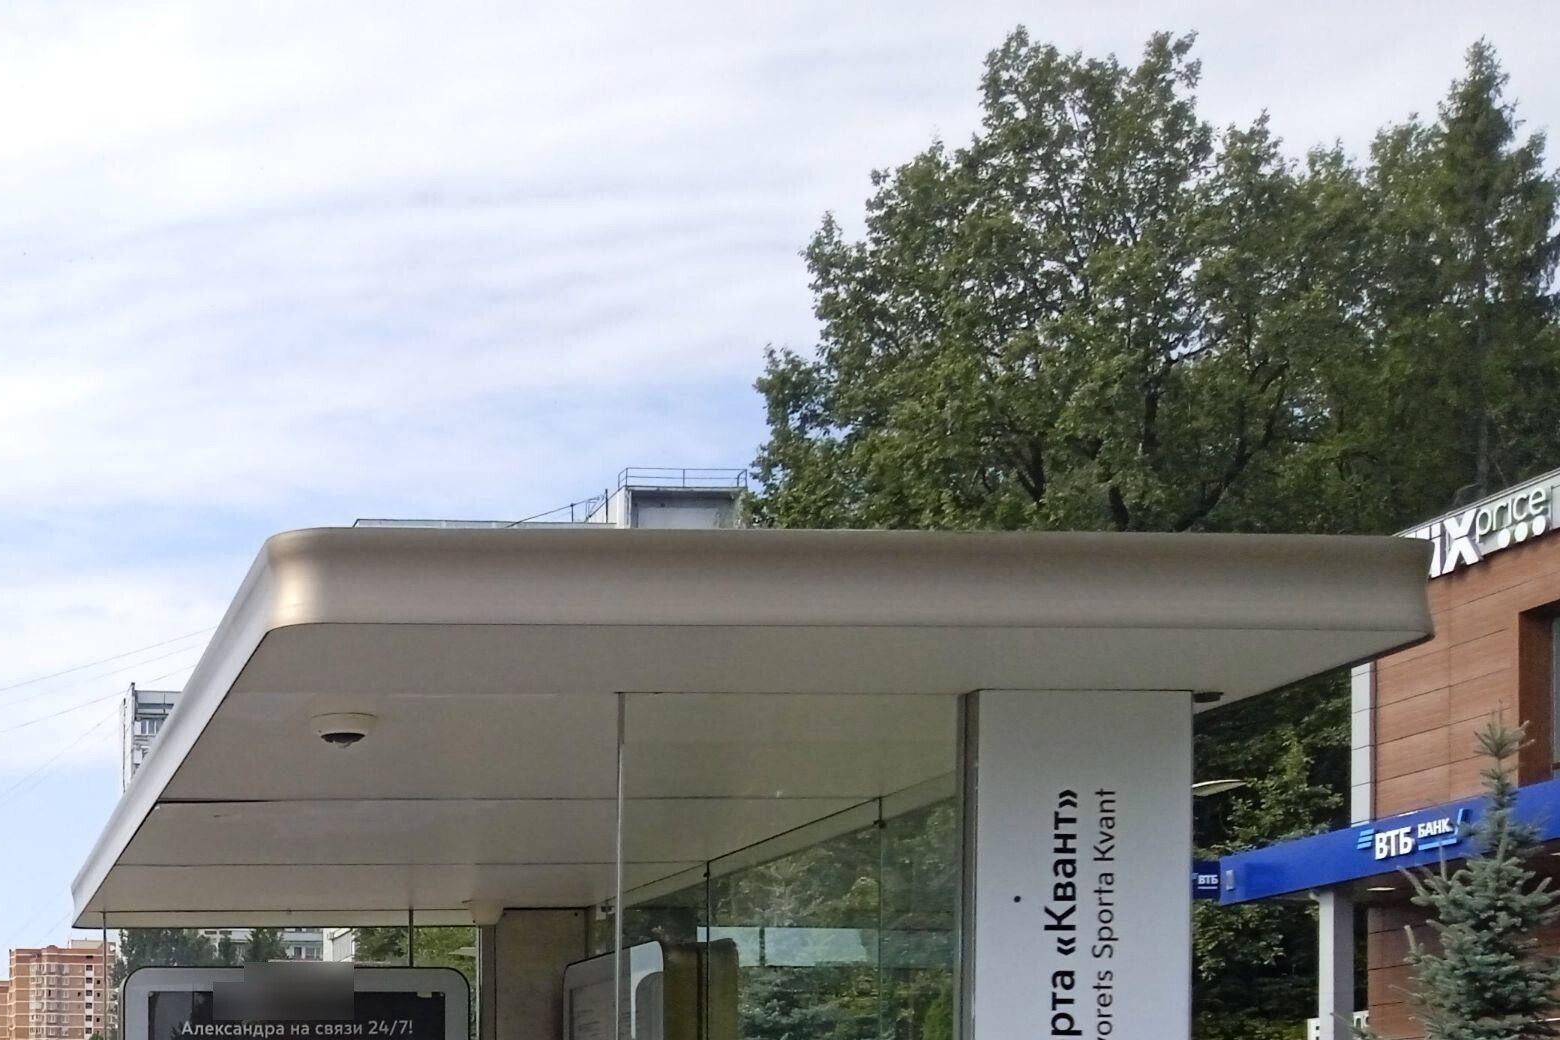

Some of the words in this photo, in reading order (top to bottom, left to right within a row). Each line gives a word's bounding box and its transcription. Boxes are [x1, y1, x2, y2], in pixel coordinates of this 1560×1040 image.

[1476, 487, 1547, 544] price
[1092, 787, 1118, 862] Kvant
[1374, 826, 1413, 860] ВТБ
[1417, 817, 1452, 838] БАНК
[1043, 788, 1079, 958] «Квант»
[1197, 873, 1219, 885] ВТБ
[1092, 871, 1120, 961] Sporta
[181, 1020, 285, 1040] Александра
[290, 1023, 310, 1035] на
[315, 1023, 363, 1035] связи
[367, 1020, 414, 1037] 24/7!
